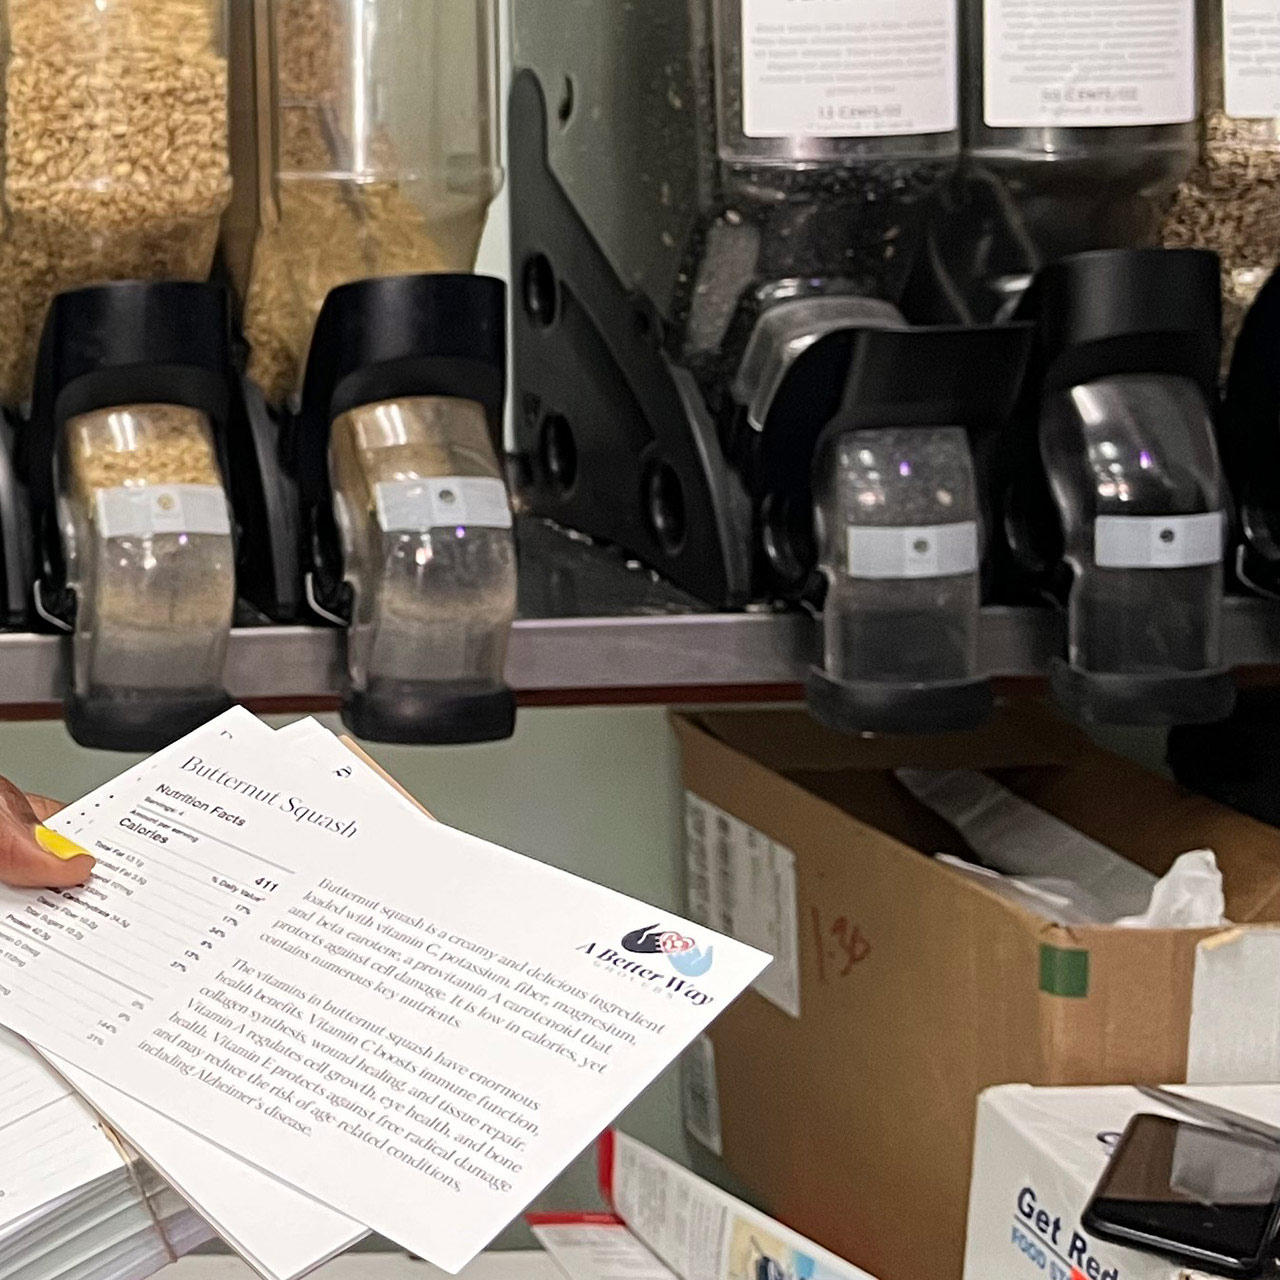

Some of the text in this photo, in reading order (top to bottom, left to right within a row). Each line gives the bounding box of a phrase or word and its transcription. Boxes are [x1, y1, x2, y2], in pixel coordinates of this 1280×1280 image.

[119, 818, 169, 844] Calories
[155, 783, 246, 826] Nutrition Facts
[180, 756, 357, 838] Butternut Squash
[255, 878, 279, 892] 411
[302, 890, 348, 915] loaded
[346, 910, 374, 927] with
[376, 923, 424, 949] vitamin
[259, 933, 311, 960] contains
[310, 956, 374, 988] numerous
[373, 981, 399, 1000] key
[271, 920, 324, 946] protects
[323, 942, 371, 966] against
[370, 962, 397, 976] cell
[449, 994, 464, 1007] It
[463, 1001, 475, 1013] is
[477, 1006, 505, 1024] low
[505, 1020, 520, 1034] in
[578, 1057, 607, 1074] yet
[288, 907, 317, 921] and
[316, 915, 344, 935] beta
[411, 961, 487, 997] provitamin
[503, 1000, 582, 1038] carotenoid
[580, 1033, 613, 1055] that
[318, 878, 380, 910] Butternut
[379, 906, 424, 929] squash
[424, 923, 436, 934] is
[448, 935, 498, 960] creamy
[497, 956, 529, 972] and
[526, 967, 589, 999] delicious
[589, 994, 666, 1034] ingredient
[575, 942, 715, 1007] A Better Way
[137, 1040, 196, 1076] including
[191, 1069, 264, 1110] Alzheimer's
[187, 997, 233, 1028] Vitamin
[245, 1030, 303, 1062] regulates
[303, 1059, 330, 1074] cell
[379, 1096, 405, 1112] eye
[454, 1135, 487, 1152] and
[484, 1146, 522, 1173] bone
[199, 987, 249, 1014] collagen
[312, 1039, 359, 1065] wound
[407, 1087, 440, 1105] and
[437, 1100, 480, 1126] tissue
[215, 970, 253, 995] health
[309, 1013, 359, 1045] Vitamin
[360, 1039, 376, 1052] C
[373, 1044, 416, 1073] boosts
[418, 1067, 477, 1101] immune
[232, 958, 538, 1111] The vitamins in butternut squash have enormous
[152, 1028, 181, 1044] and
[176, 1039, 205, 1057] may
[203, 1053, 247, 1078] reduce
[247, 1073, 270, 1089] the
[269, 1086, 295, 1103] risk
[295, 1099, 316, 1110] of
[310, 1107, 390, 1149] age-related
[213, 1031, 261, 1063] Vitamin
[269, 1065, 325, 1096] protects
[325, 1092, 376, 1121] against
[375, 1115, 405, 1135] free
[404, 1132, 457, 1161] radical
[454, 1157, 512, 1192] damage
[1017, 1186, 1062, 1246] Get
